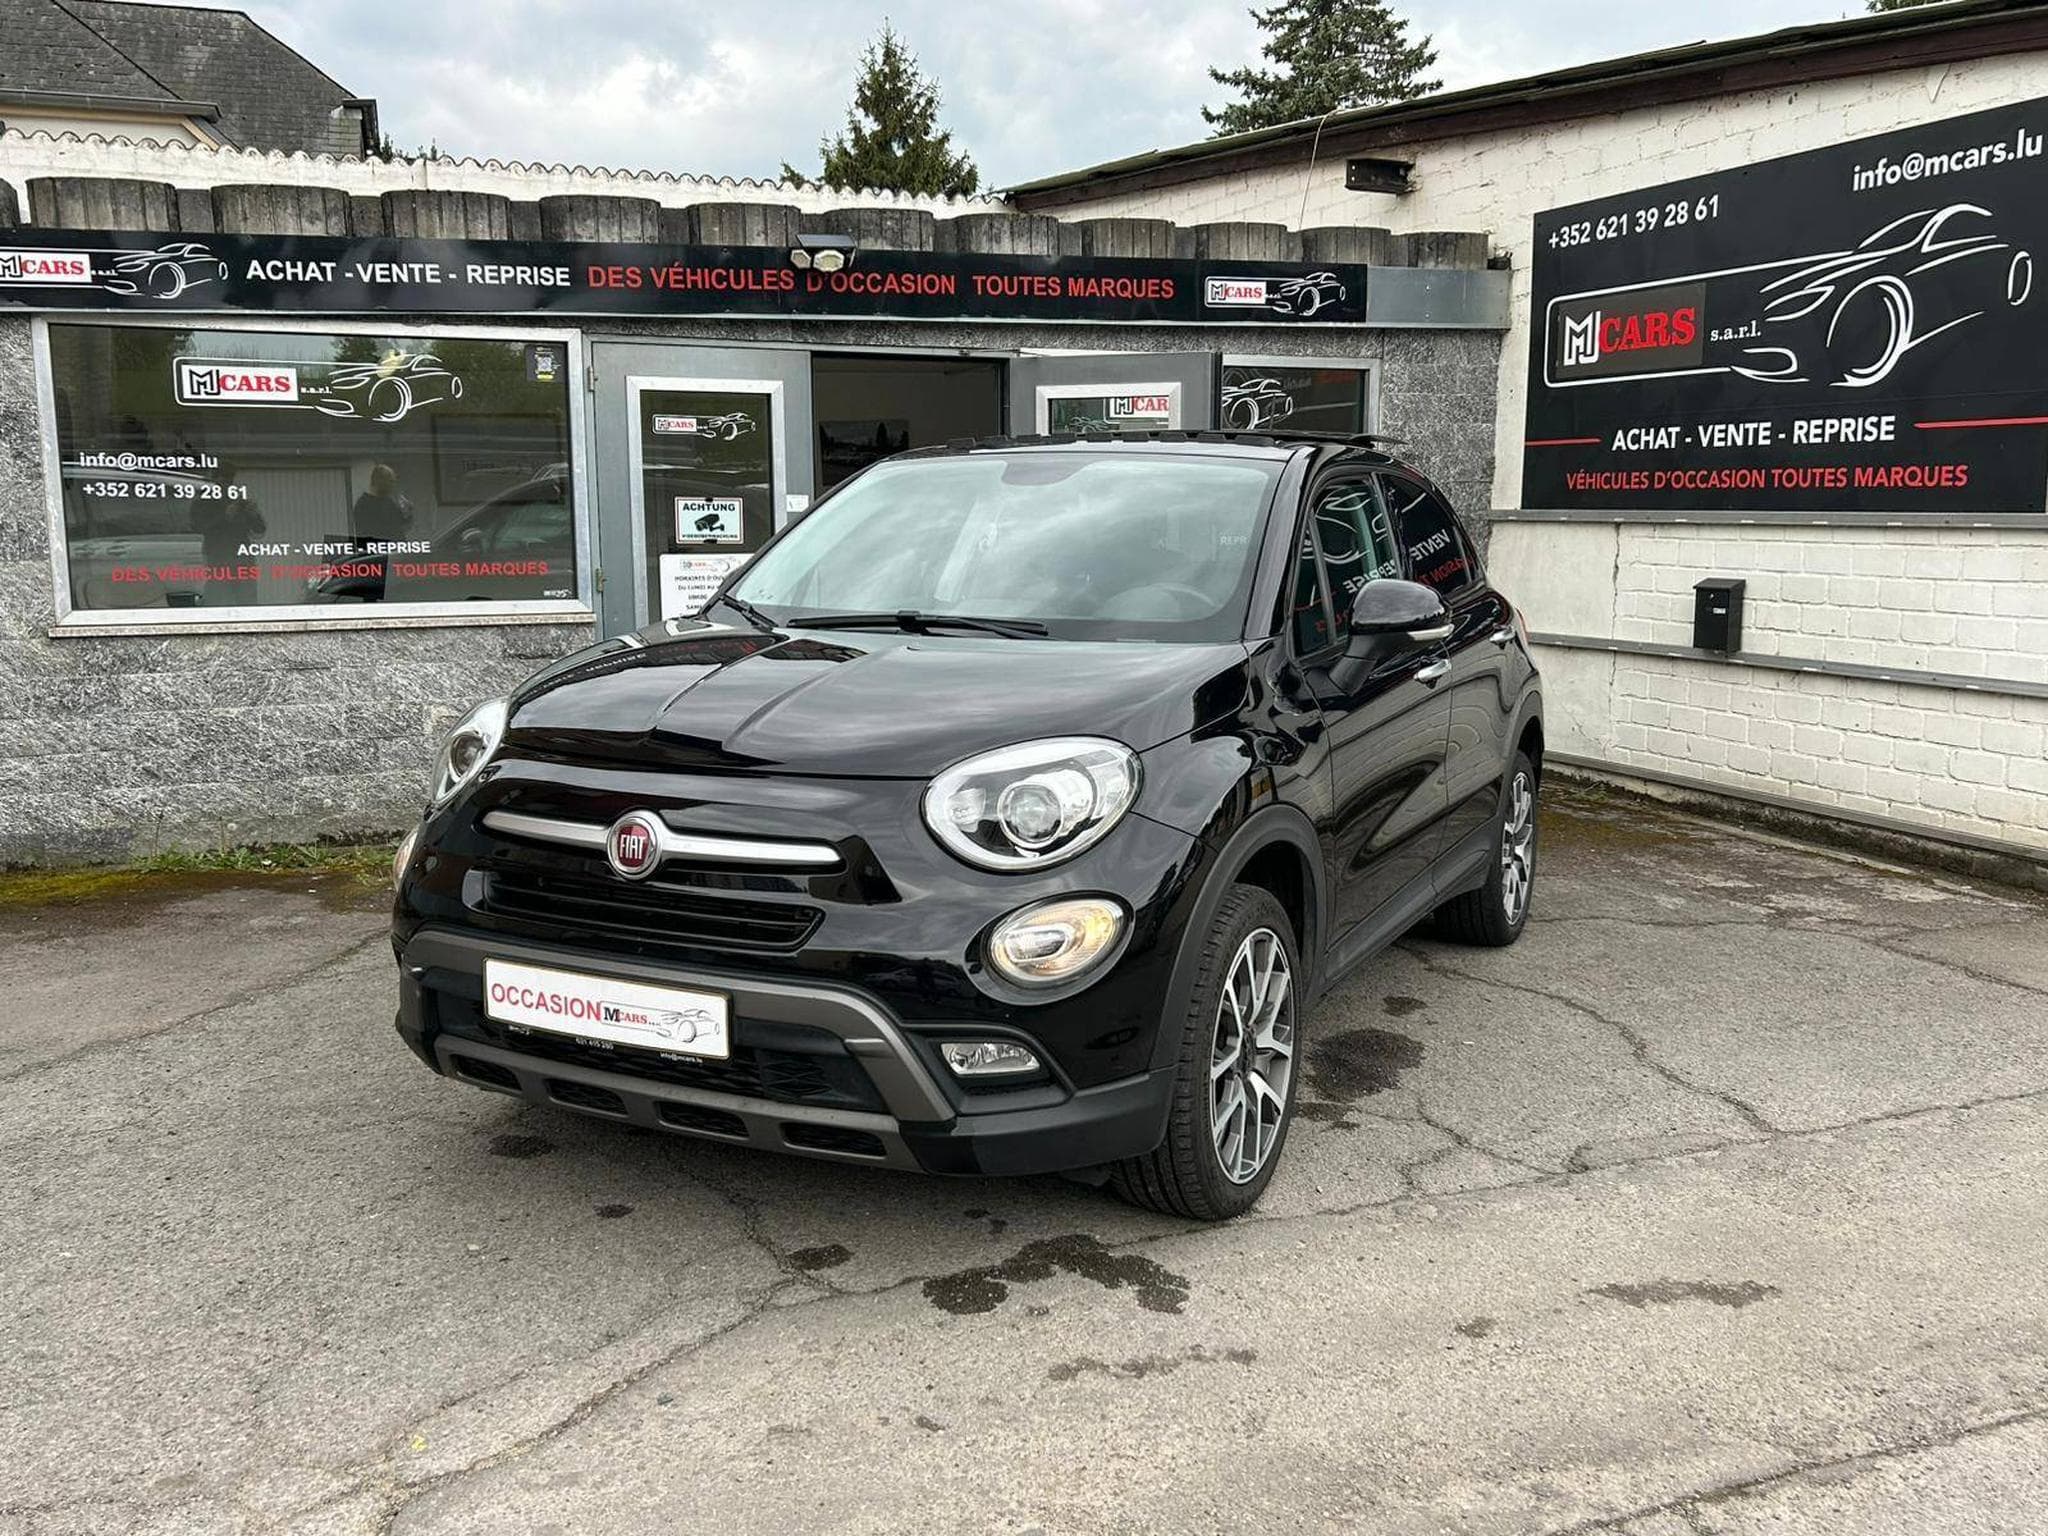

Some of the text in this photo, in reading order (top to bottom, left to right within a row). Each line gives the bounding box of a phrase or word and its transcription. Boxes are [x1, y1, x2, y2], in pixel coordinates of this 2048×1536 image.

[1852, 127, 2044, 192] info@mcars.lu
[1548, 194, 1720, 249] +352 621 39 28 61
[245, 259, 337, 282] ACHAT
[355, 262, 442, 284] VENTE
[466, 263, 571, 287] REPRISE
[587, 265, 642, 289] DES
[649, 261, 795, 292] VÉHICULES
[806, 271, 956, 296] D'OCCASION
[971, 274, 1062, 297] TOUTES
[1067, 276, 1175, 300] MARQUES
[1709, 319, 1762, 342] s.a.r.l.
[1610, 426, 1681, 452] ACHAT
[1698, 421, 1772, 448] VENTE
[1792, 414, 1896, 445] REPRISE
[79, 451, 219, 471] info@mcars.lu
[1566, 464, 1969, 490] VÉHICULES D'OCCASION TOUTES MARQUES
[82, 481, 248, 500] +352 621 39 28 61
[682, 502, 736, 512] ACHTUNG
[236, 543, 290, 556] ACHAT
[302, 543, 354, 556] VENTE
[367, 541, 431, 555] REPRISE
[111, 565, 152, 582] DES
[393, 562, 461, 578] TOUTES
[465, 560, 550, 577] MARQUES
[619, 834, 647, 860] FIAT
[491, 982, 601, 1021] OCCASION
